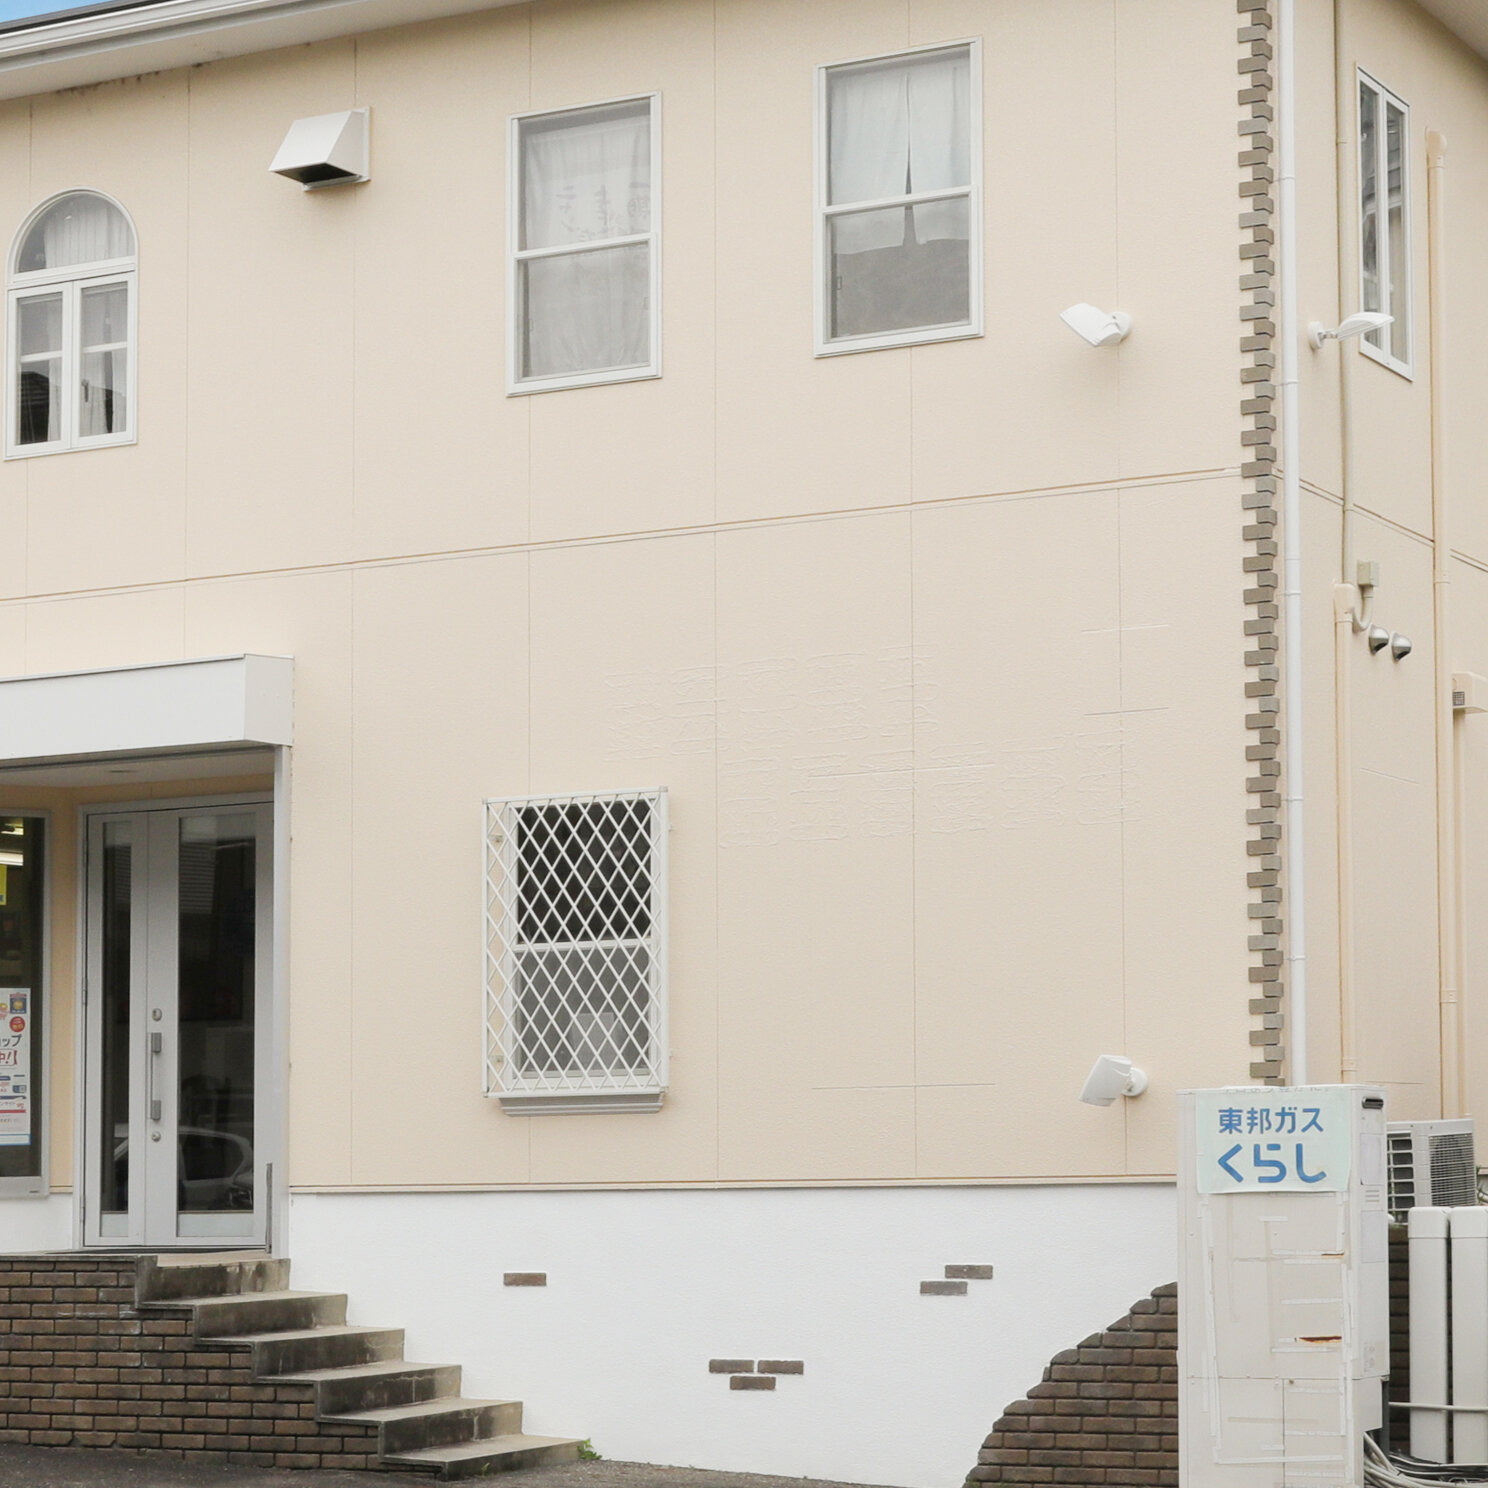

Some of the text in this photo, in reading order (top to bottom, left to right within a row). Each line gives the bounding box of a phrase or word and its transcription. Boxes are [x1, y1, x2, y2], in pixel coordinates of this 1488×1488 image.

[1218, 1107, 1325, 1135] 東邦ガス
[1218, 1144, 1327, 1183] くらし
